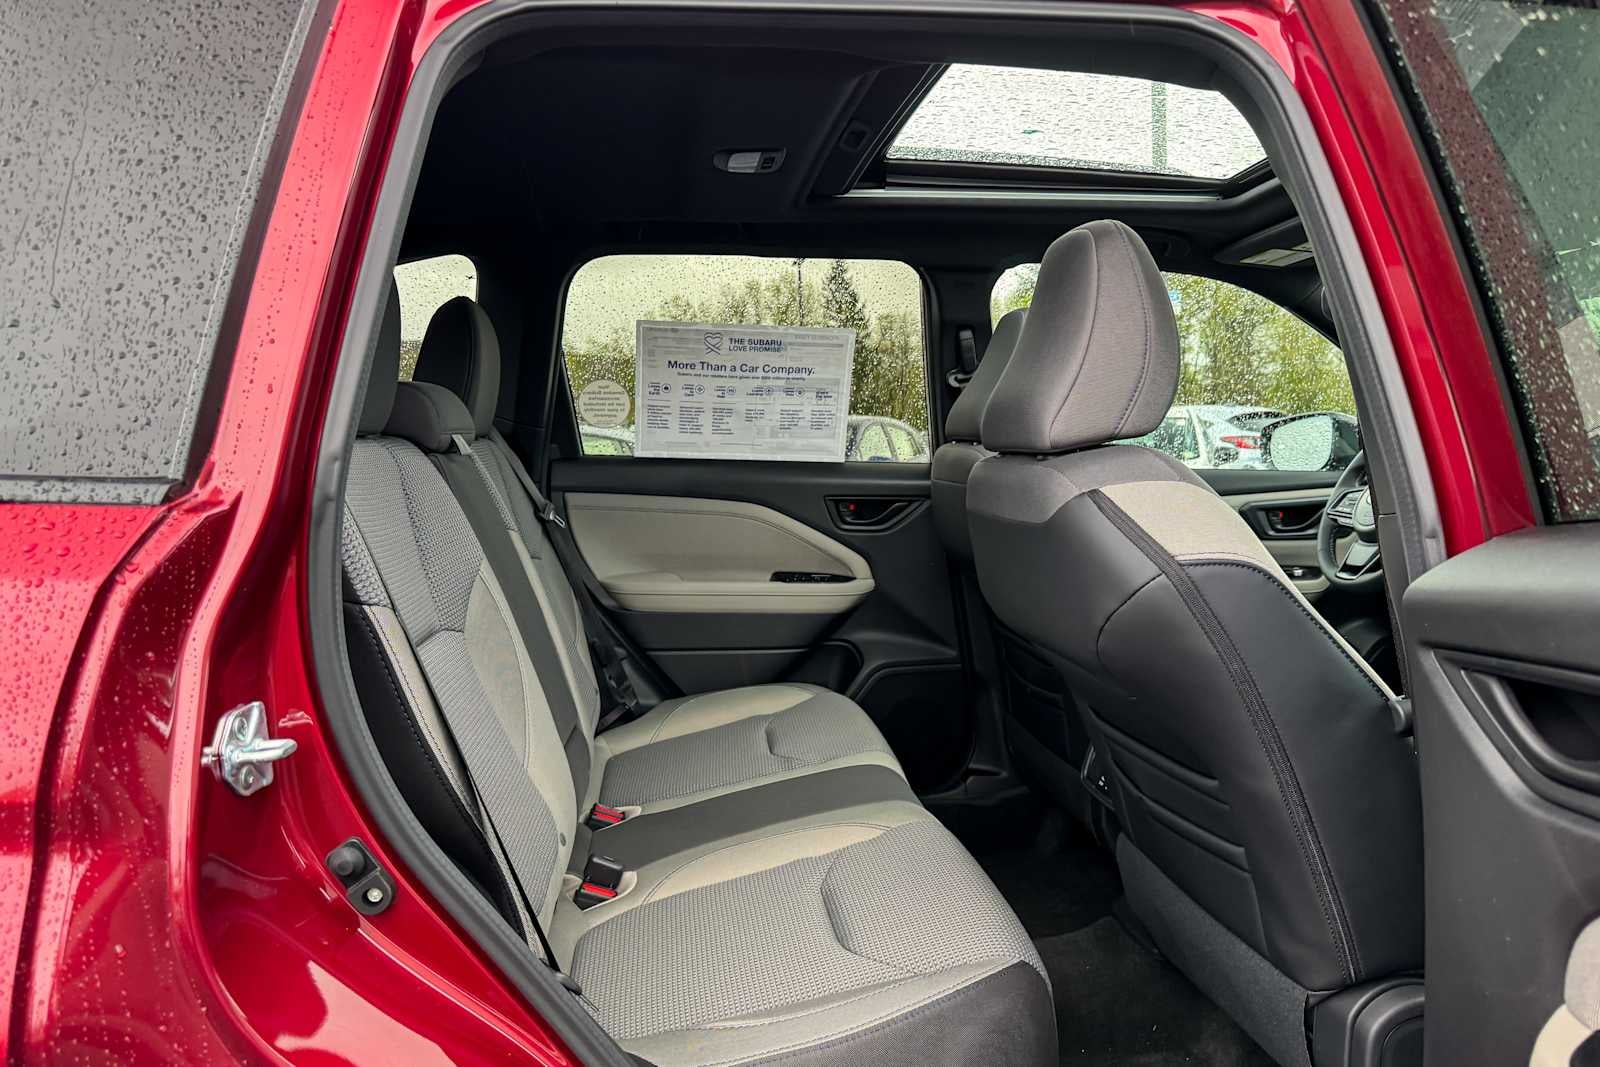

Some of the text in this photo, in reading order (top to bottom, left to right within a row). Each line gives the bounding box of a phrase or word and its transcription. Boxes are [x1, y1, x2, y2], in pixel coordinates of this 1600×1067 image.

[728, 337, 782, 346] THE SUBARU
[667, 360, 696, 370] More
[699, 361, 727, 371] Than
[739, 363, 760, 373] Car
[762, 364, 816, 376] Company.
